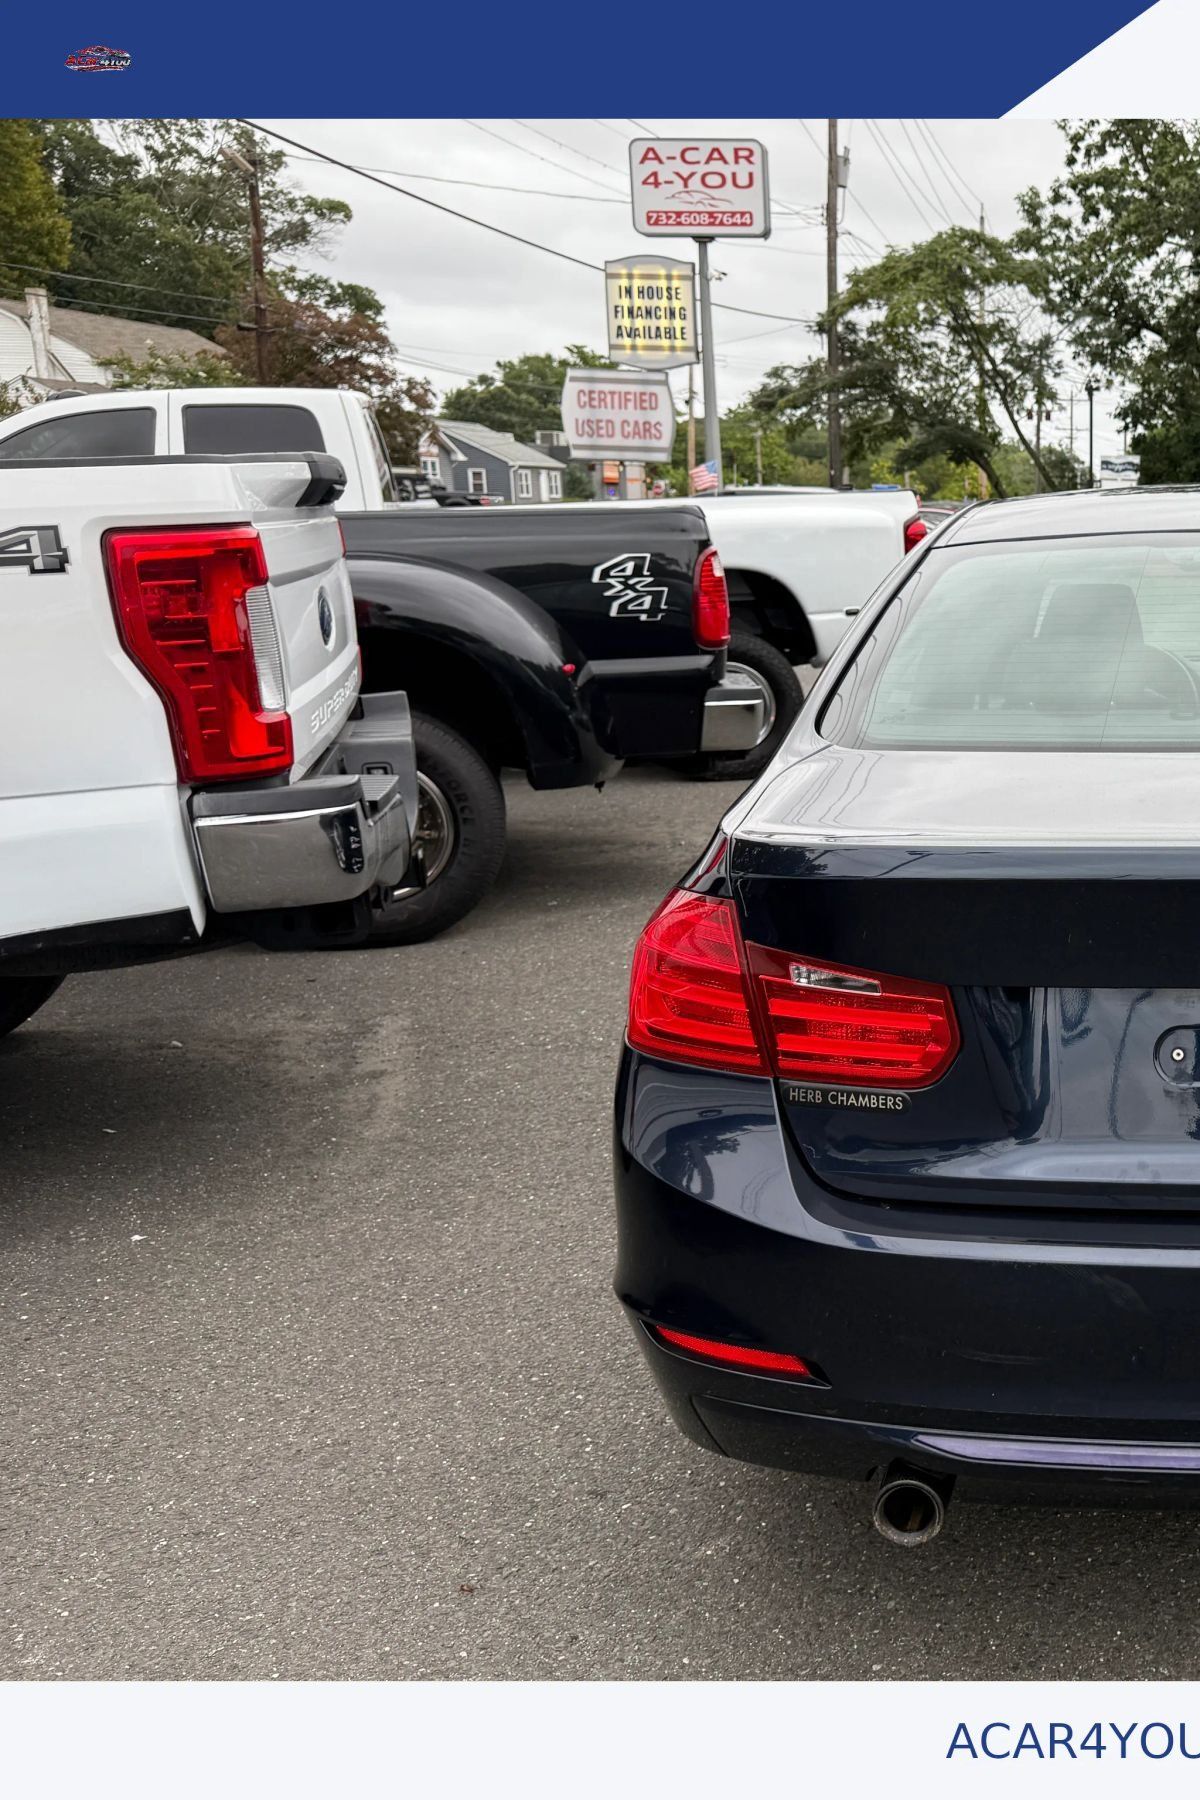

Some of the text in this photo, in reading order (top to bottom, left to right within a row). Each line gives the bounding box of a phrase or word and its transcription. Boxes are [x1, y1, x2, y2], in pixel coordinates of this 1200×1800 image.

[639, 147, 755, 165] A-CAR
[641, 171, 754, 189] 4-YOU
[648, 212, 751, 225] 732-608-7644
[618, 285, 681, 301] IN HOUSE
[614, 304, 687, 321] FINANCING
[615, 325, 687, 341] AVAILABLE
[577, 389, 659, 411] CERTIFIED
[575, 418, 663, 441] USED CARS
[789, 1087, 904, 1111] HERB CHAMBERS
